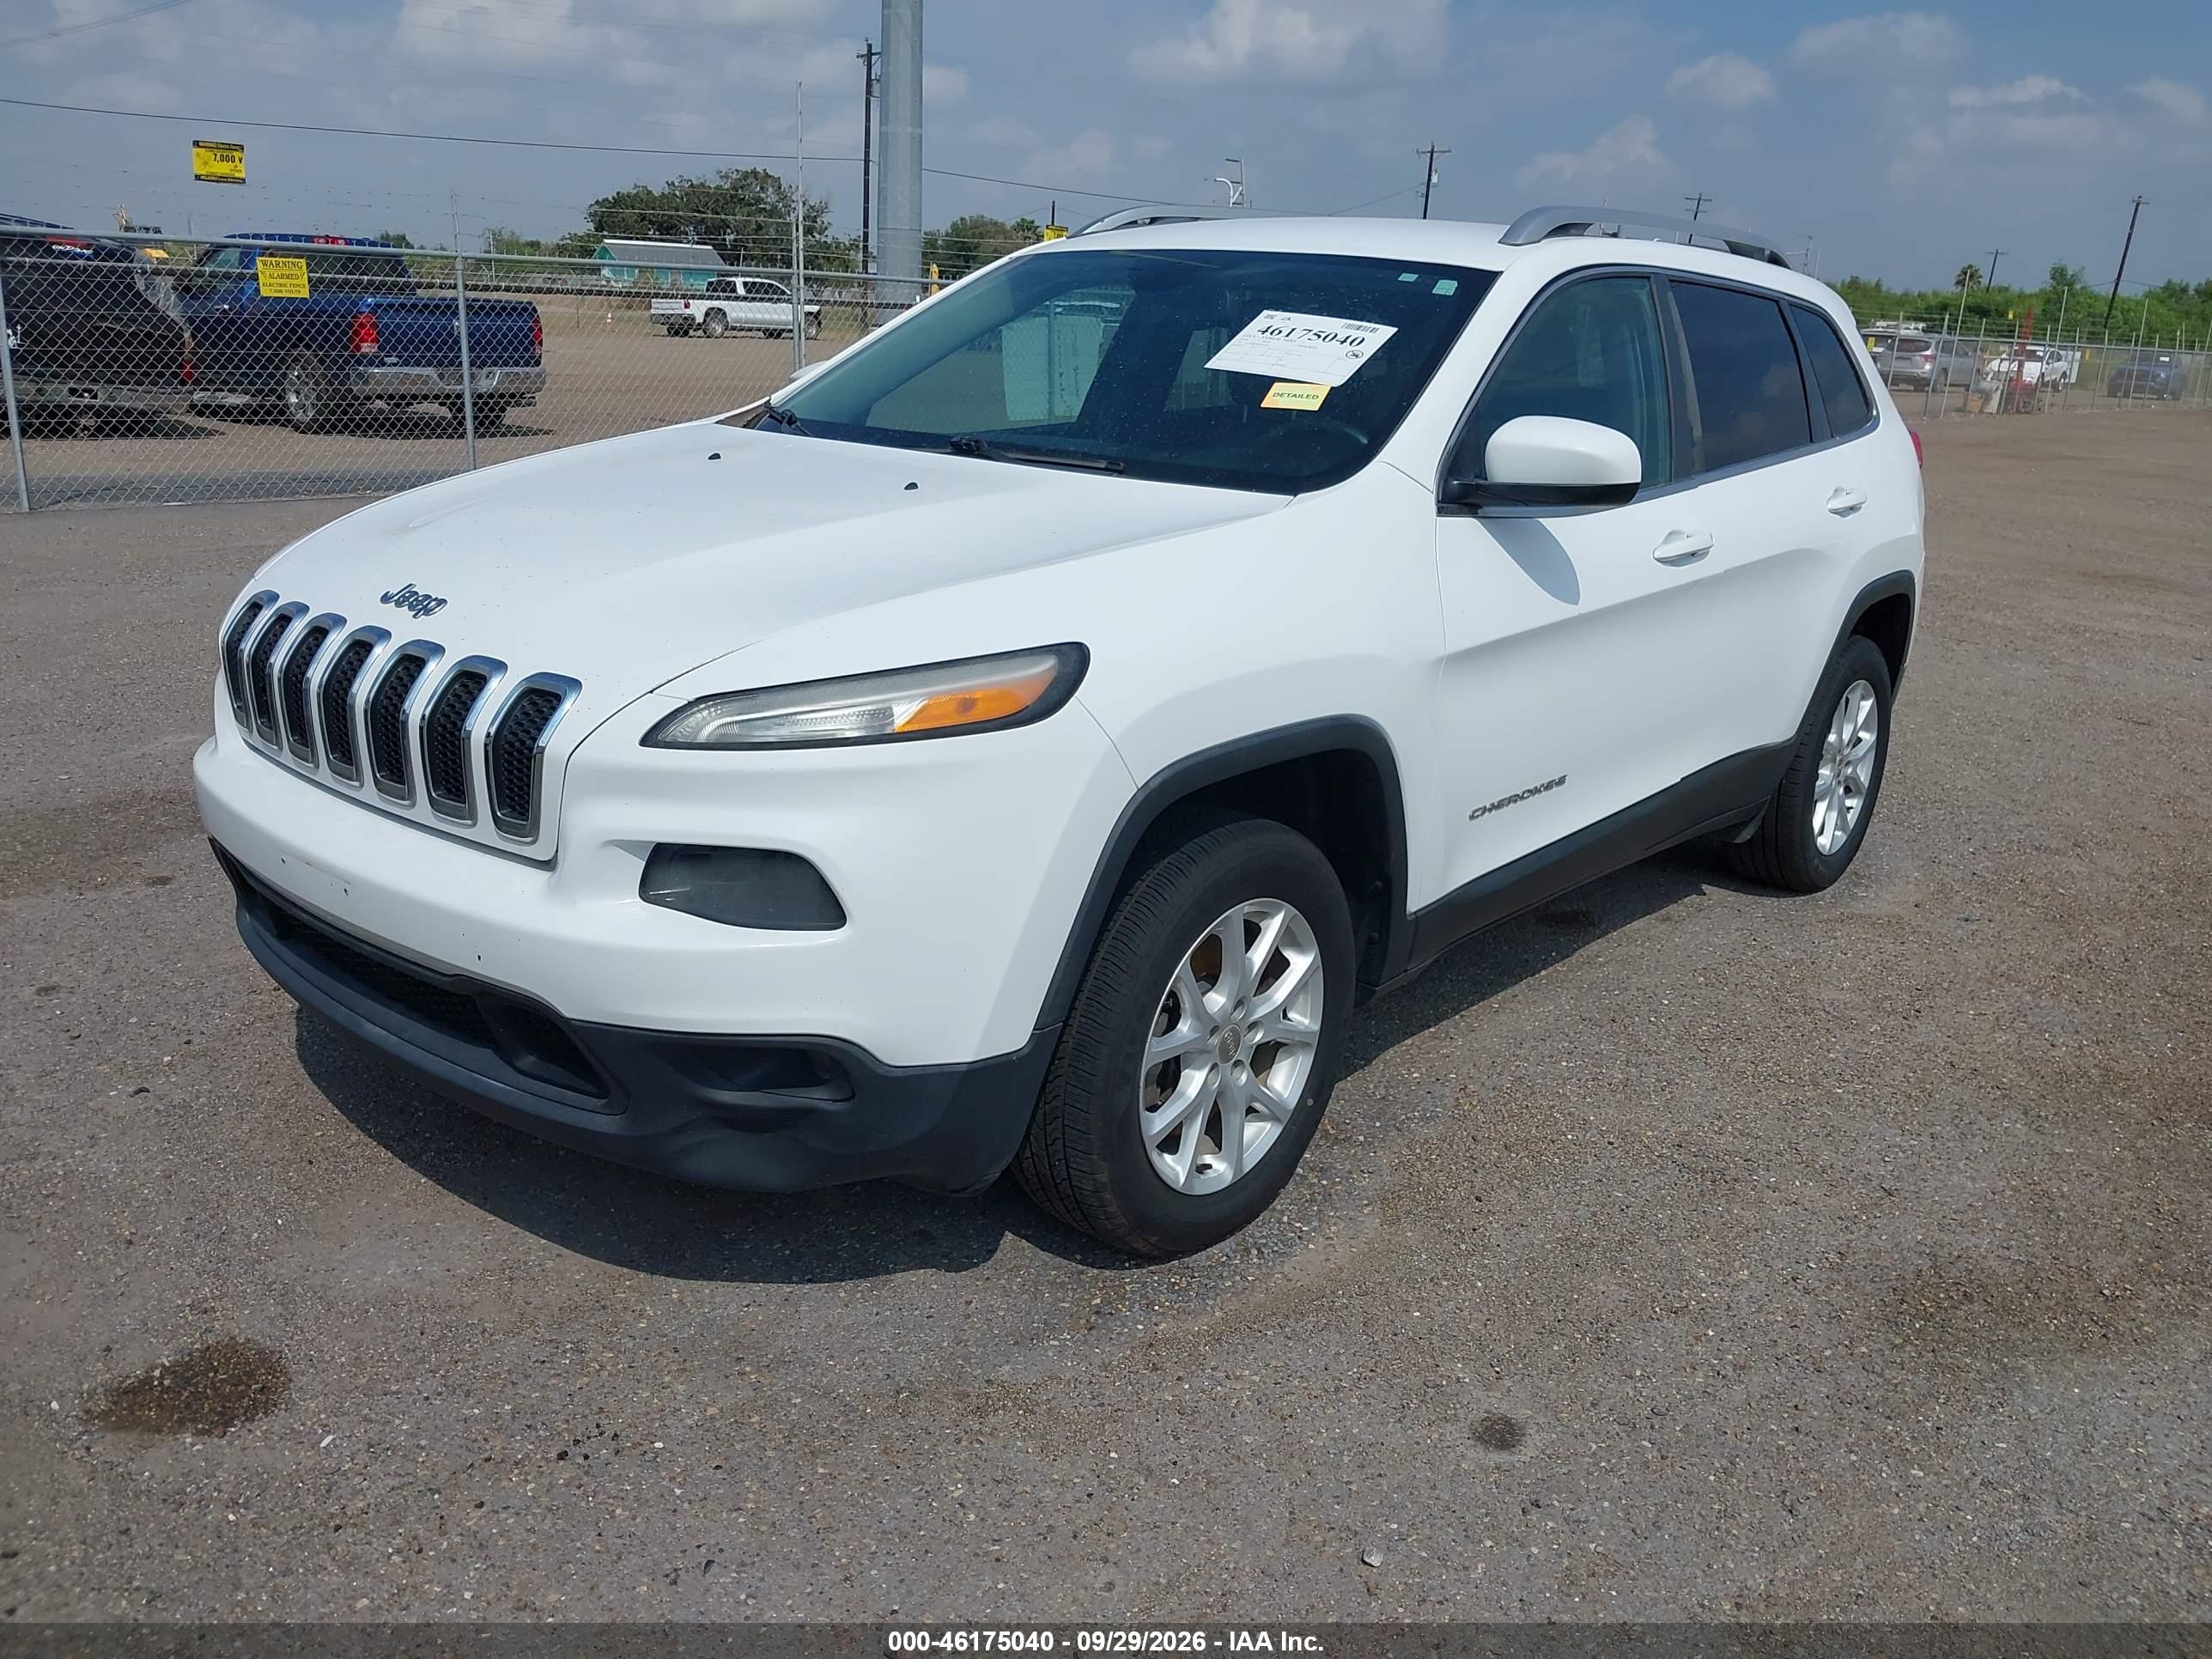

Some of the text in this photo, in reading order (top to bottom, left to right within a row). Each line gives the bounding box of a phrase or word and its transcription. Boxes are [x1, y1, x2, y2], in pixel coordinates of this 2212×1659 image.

[213, 153, 236, 164] 7,000
[261, 259, 303, 270] WARNING
[268, 272, 300, 281] ALARMED
[1257, 324, 1366, 349] 46175040
[1272, 392, 1320, 401] DETAILED
[380, 583, 448, 620] Jeep
[1468, 773, 1568, 822] CHEROKEE
